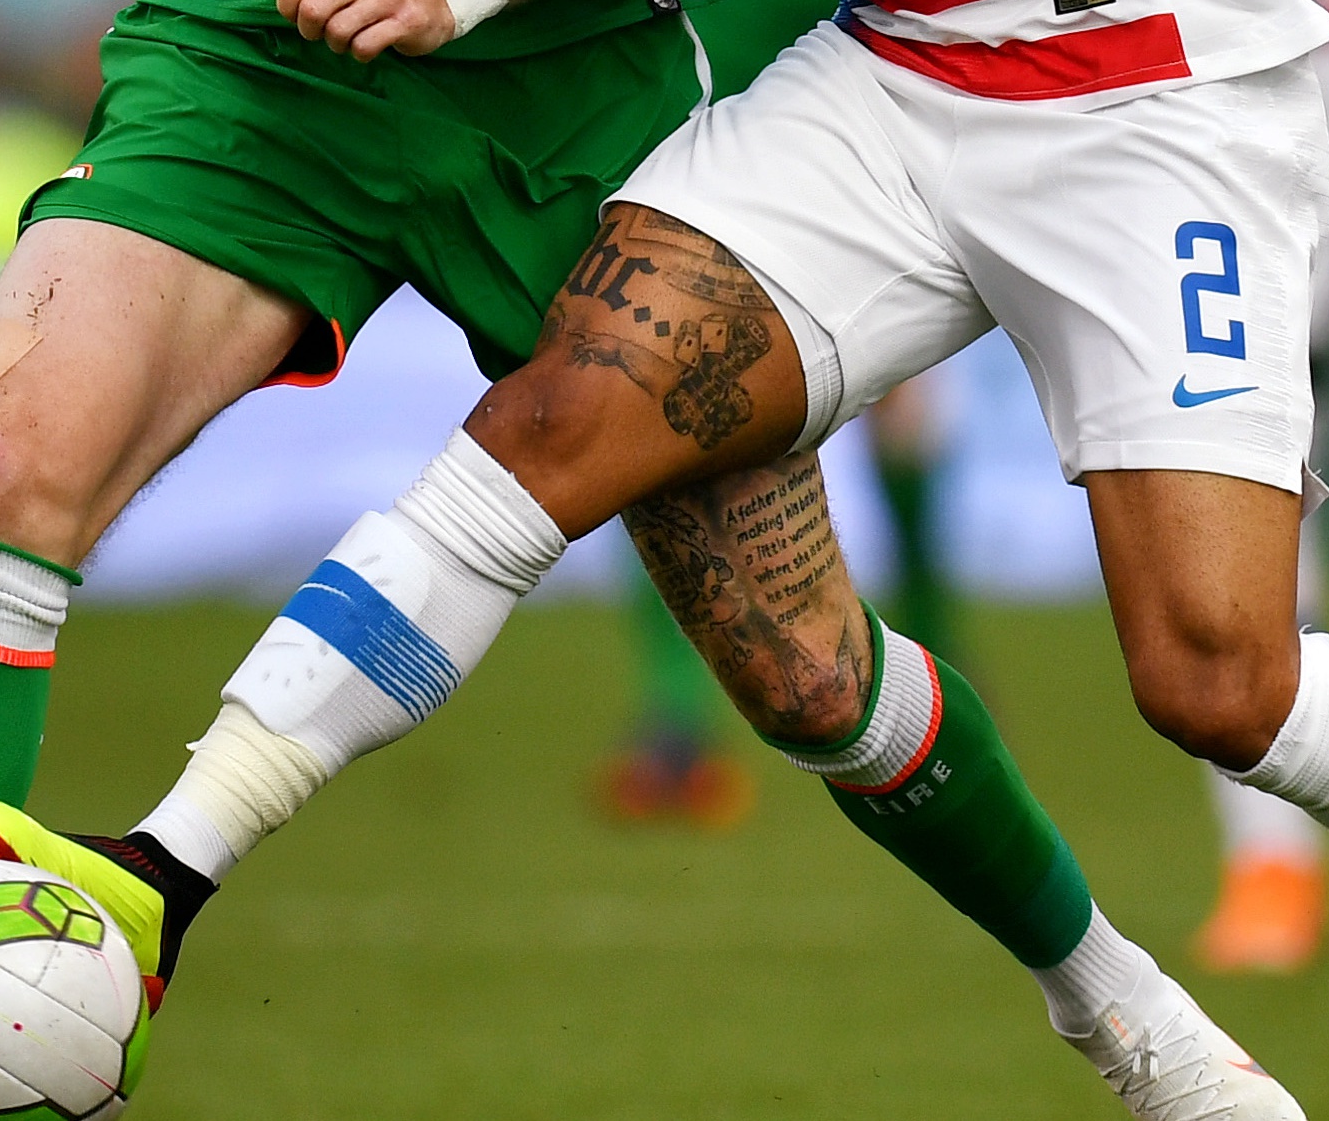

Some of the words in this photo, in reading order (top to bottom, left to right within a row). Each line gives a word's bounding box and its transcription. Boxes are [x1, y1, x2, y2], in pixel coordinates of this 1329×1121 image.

[1174, 220, 1246, 361] 2
[726, 507, 738, 528] A
[738, 490, 777, 523] father
[777, 483, 787, 498] is
[736, 513, 784, 546] making
[784, 502, 799, 521] his
[756, 537, 787, 562] little
[792, 551, 811, 570] she
